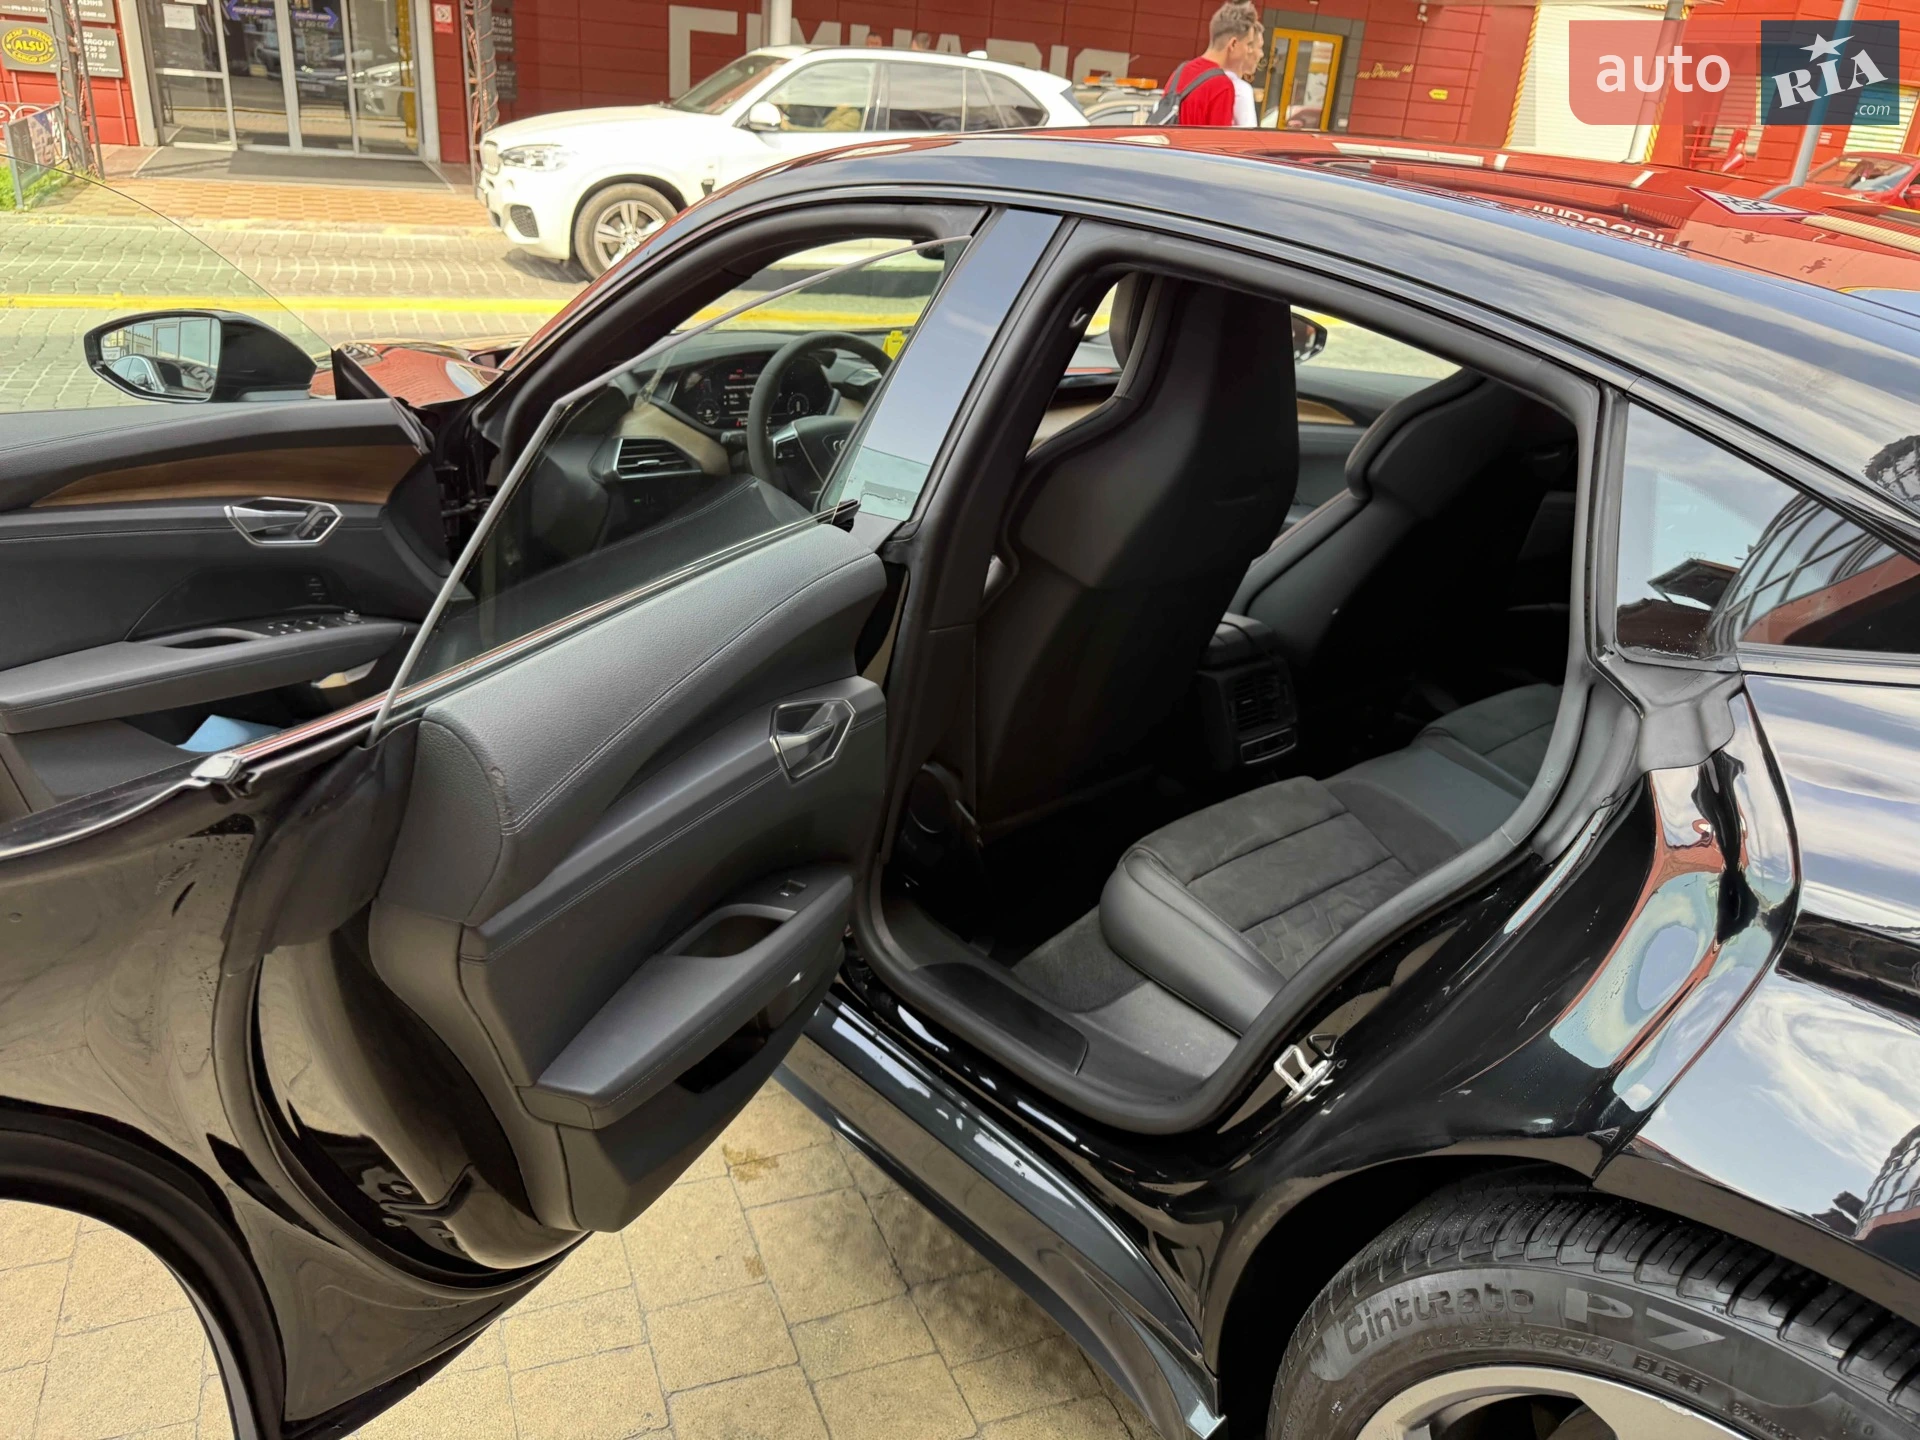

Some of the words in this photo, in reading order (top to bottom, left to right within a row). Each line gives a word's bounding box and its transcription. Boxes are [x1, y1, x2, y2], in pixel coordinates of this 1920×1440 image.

[15, 40, 44, 51] ALSU
[83, 38, 103, 46] ARGO
[1343, 1283, 1534, 1355] Cinturato
[1565, 1287, 1726, 1350] P7
[1420, 1331, 1465, 1352] ALL
[1474, 1328, 1613, 1359] SEASON
